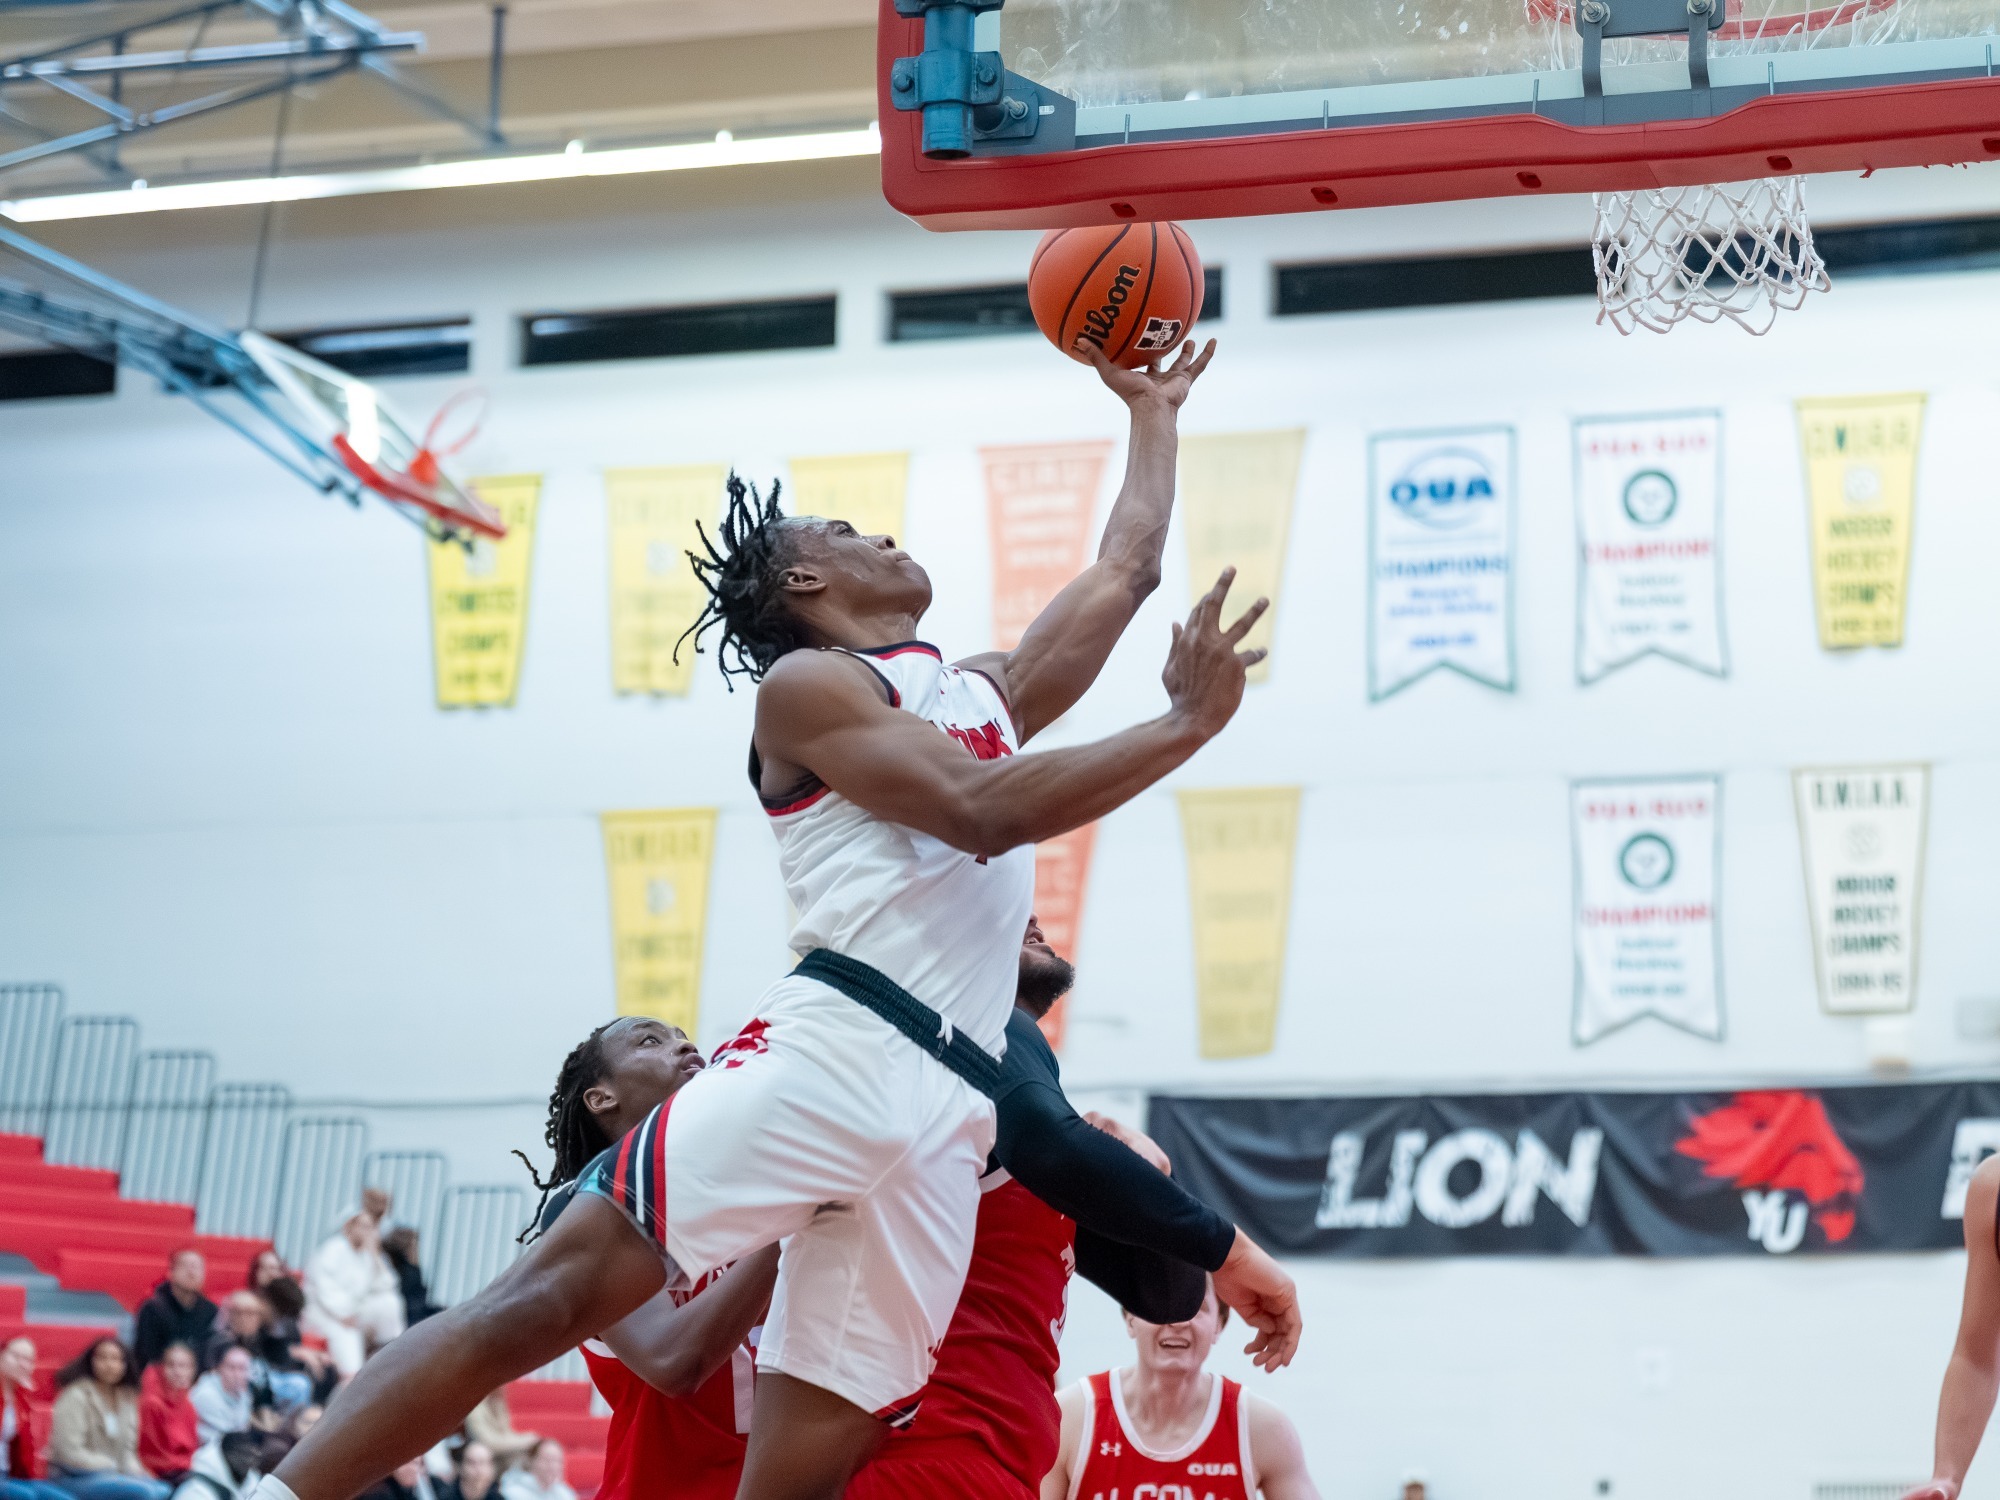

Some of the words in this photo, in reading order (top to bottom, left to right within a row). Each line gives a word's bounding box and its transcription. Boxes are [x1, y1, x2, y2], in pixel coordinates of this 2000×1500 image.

[1153, 321, 1172, 349] SPORTS
[1391, 477, 1494, 506] OUA
[1314, 1127, 1602, 1229] LION
[1741, 1190, 1808, 1253] YU
[1187, 1463, 1237, 1476] OUA
